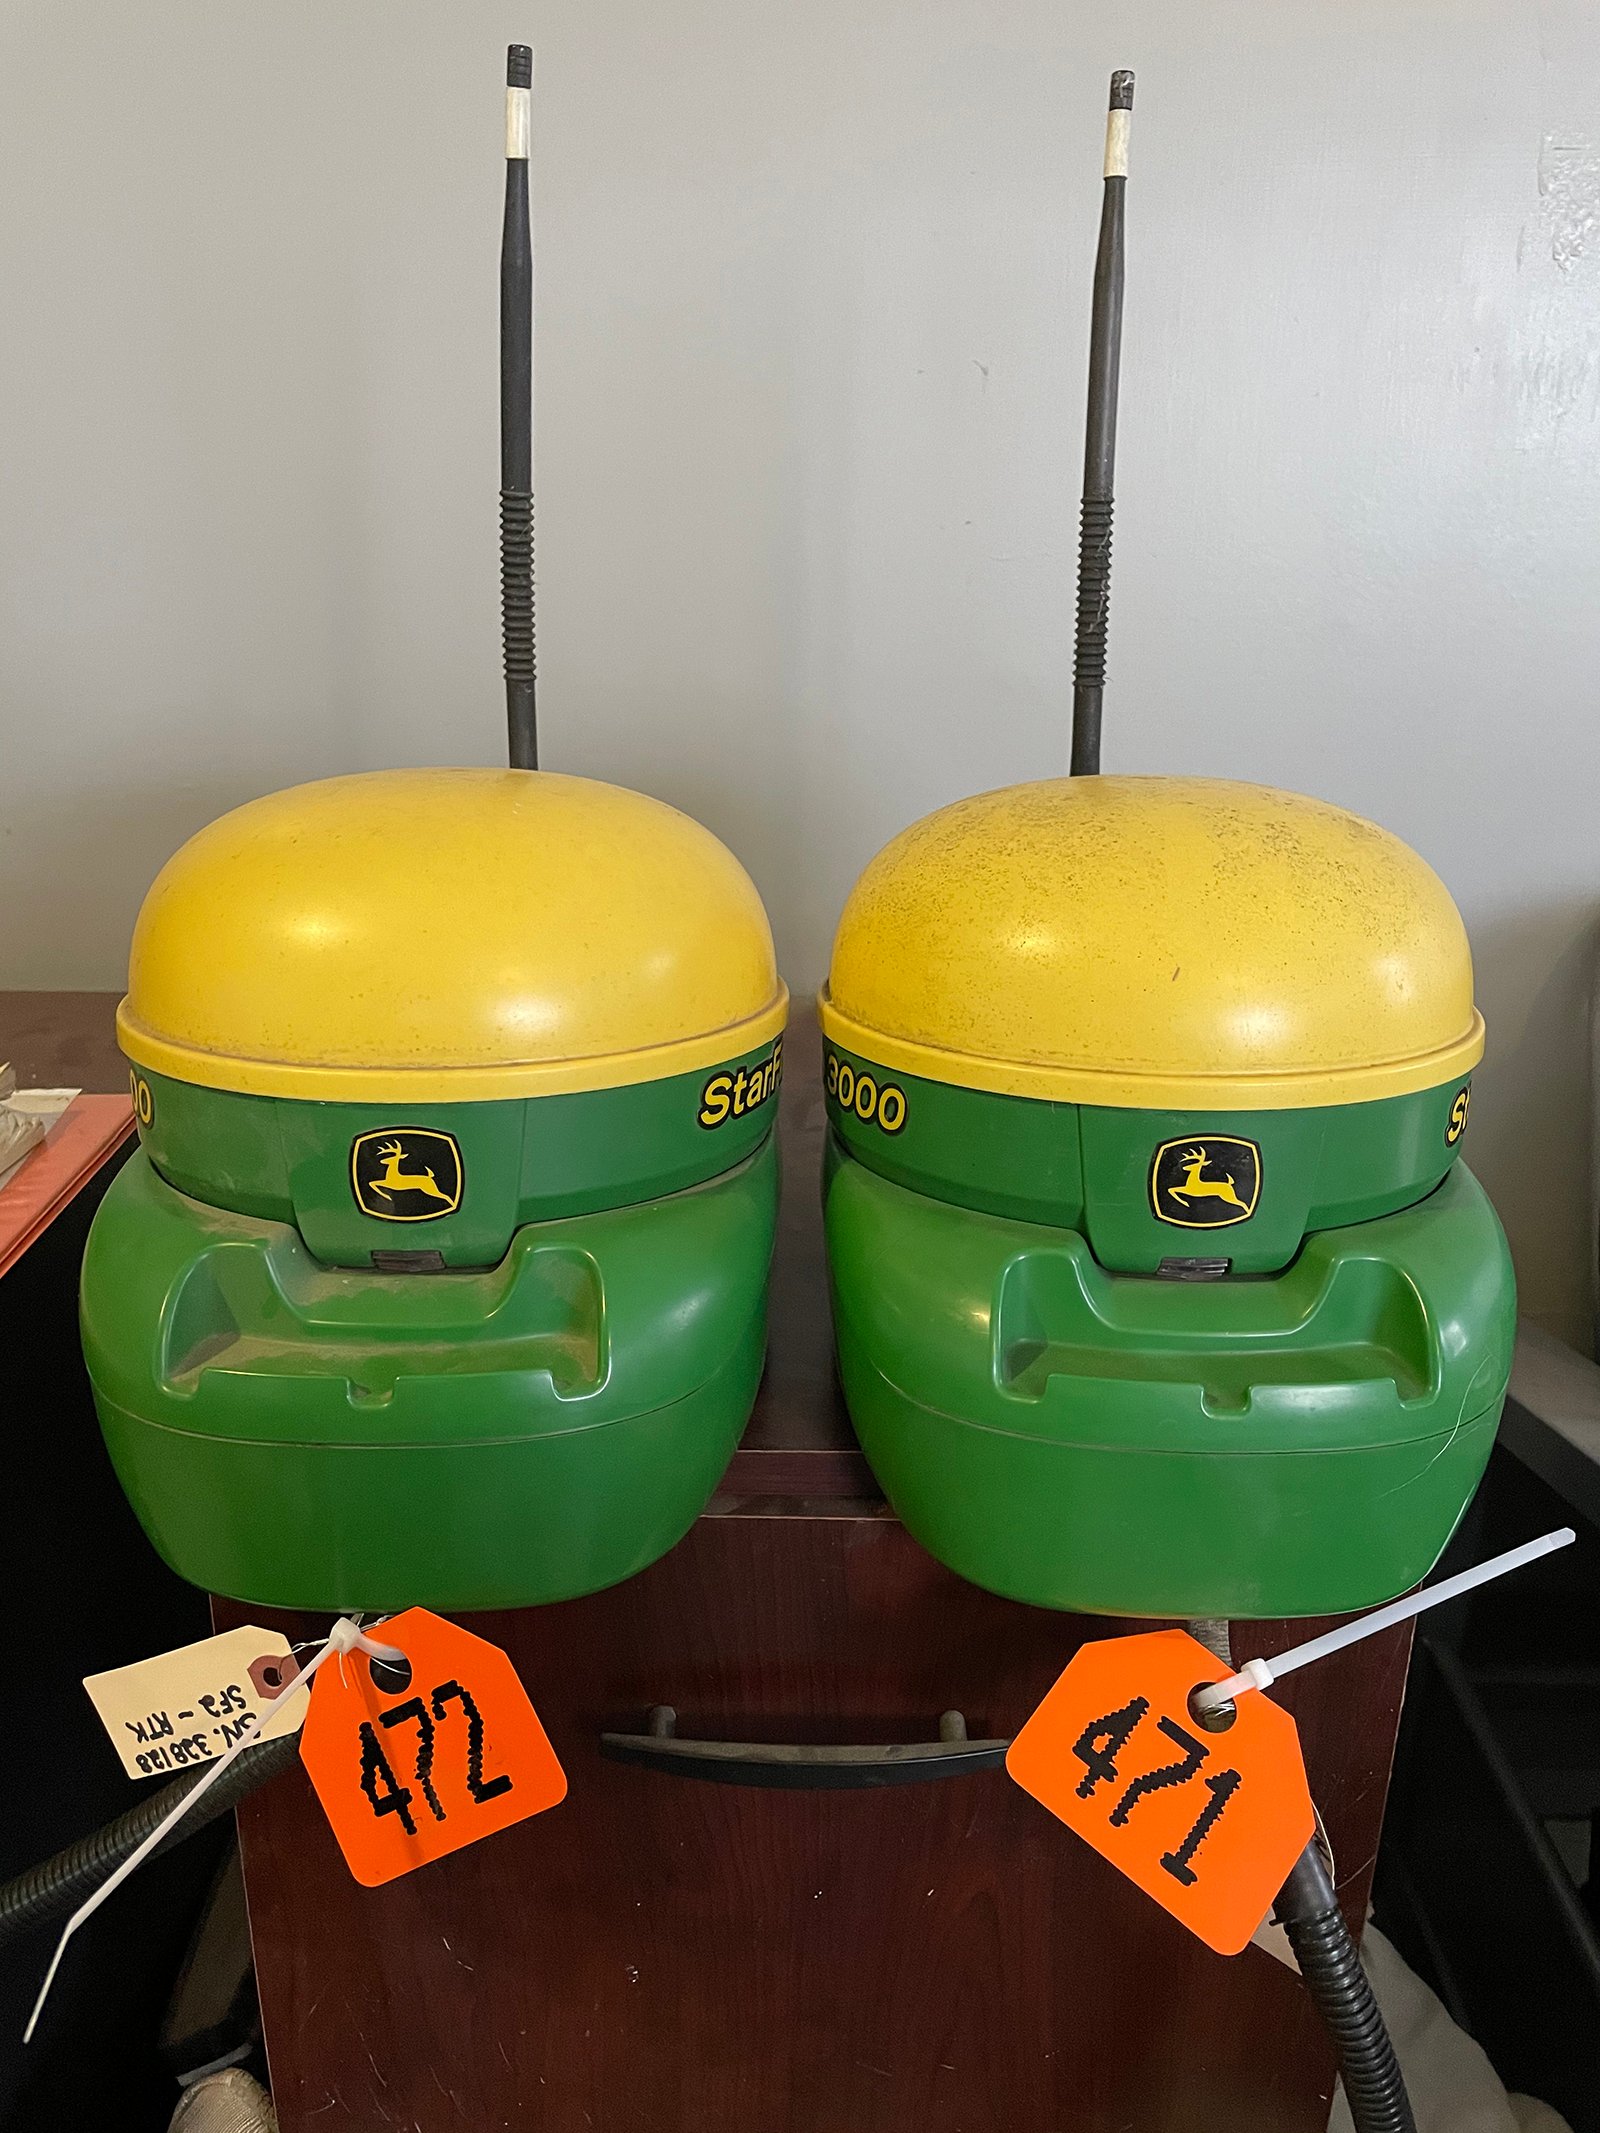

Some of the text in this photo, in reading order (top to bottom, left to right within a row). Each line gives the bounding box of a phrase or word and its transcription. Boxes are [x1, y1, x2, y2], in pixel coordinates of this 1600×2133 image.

[826, 1053, 906, 1132] 3000
[125, 1711, 174, 1743] RTK
[198, 1685, 246, 1718] SF2
[136, 1733, 213, 1773] 328128
[359, 1680, 514, 1835] 472
[1072, 1696, 1242, 1886] 471
